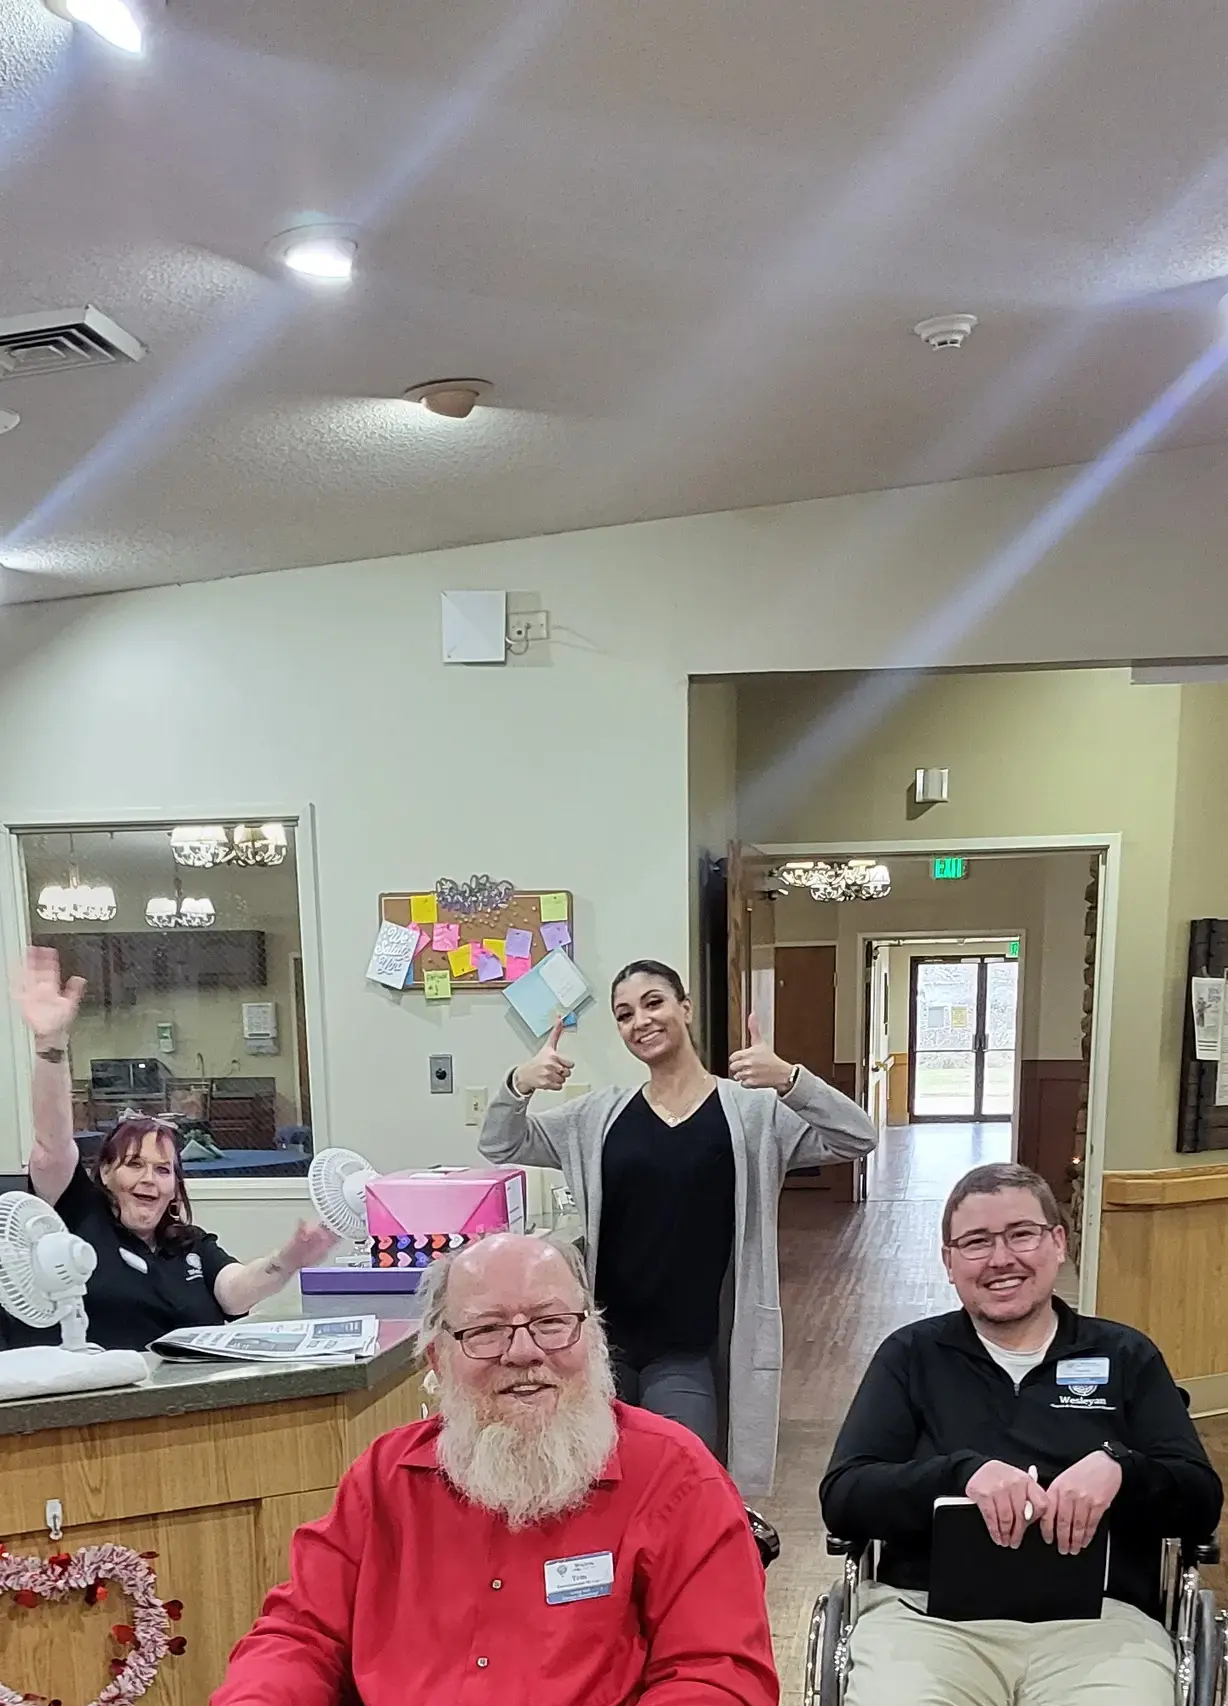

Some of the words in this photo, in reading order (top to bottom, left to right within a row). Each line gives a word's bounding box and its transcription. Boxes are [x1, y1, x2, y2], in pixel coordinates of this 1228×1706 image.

[935, 858, 962, 878] EXIT
[386, 926, 410, 945] We
[374, 940, 411, 962] Salute
[1059, 1396, 1107, 1406] Wesleyan
